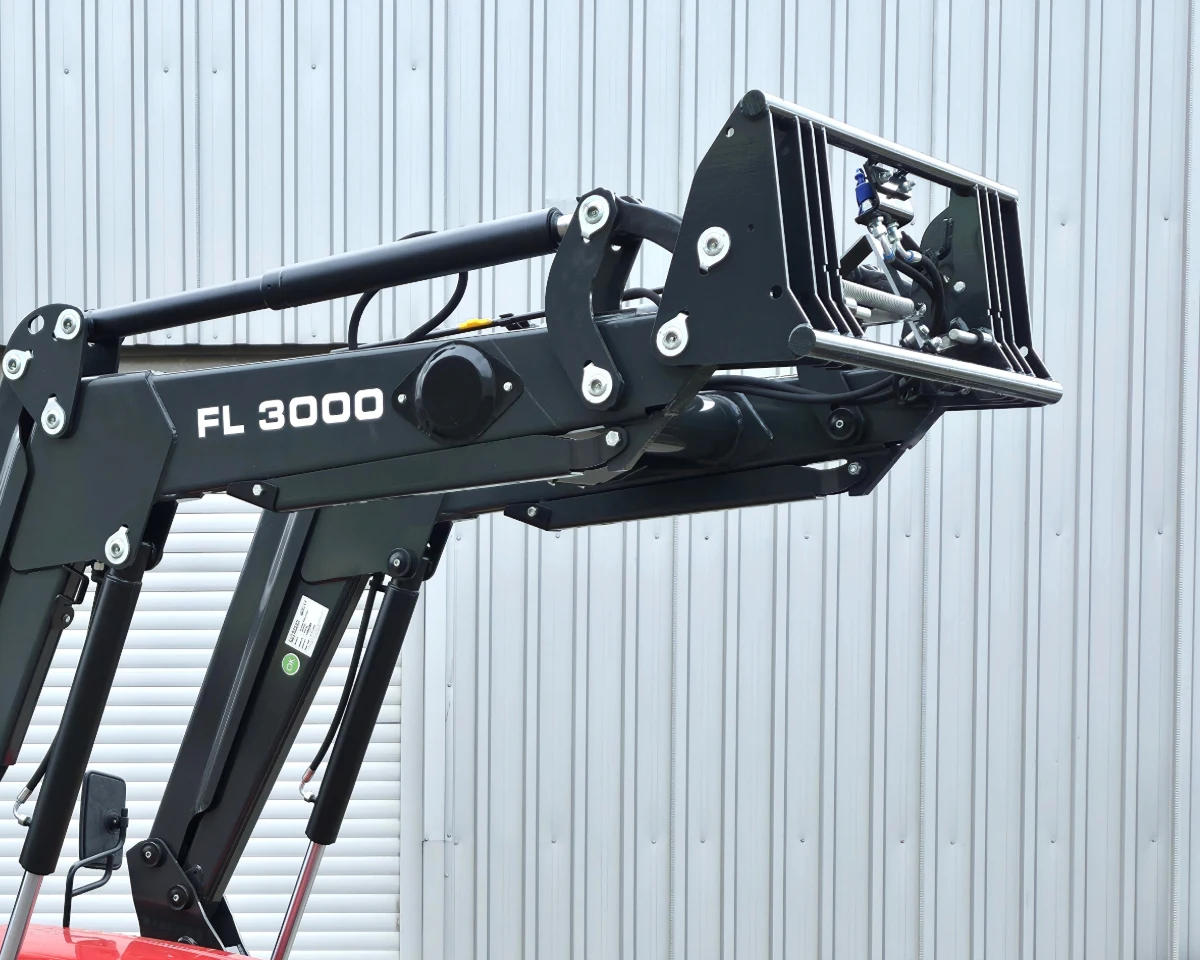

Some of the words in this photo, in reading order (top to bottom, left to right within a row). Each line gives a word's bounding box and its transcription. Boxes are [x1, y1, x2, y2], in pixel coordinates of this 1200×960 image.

[197, 404, 245, 438] FL
[258, 387, 384, 431] 3000
[286, 656, 296, 671] OK
